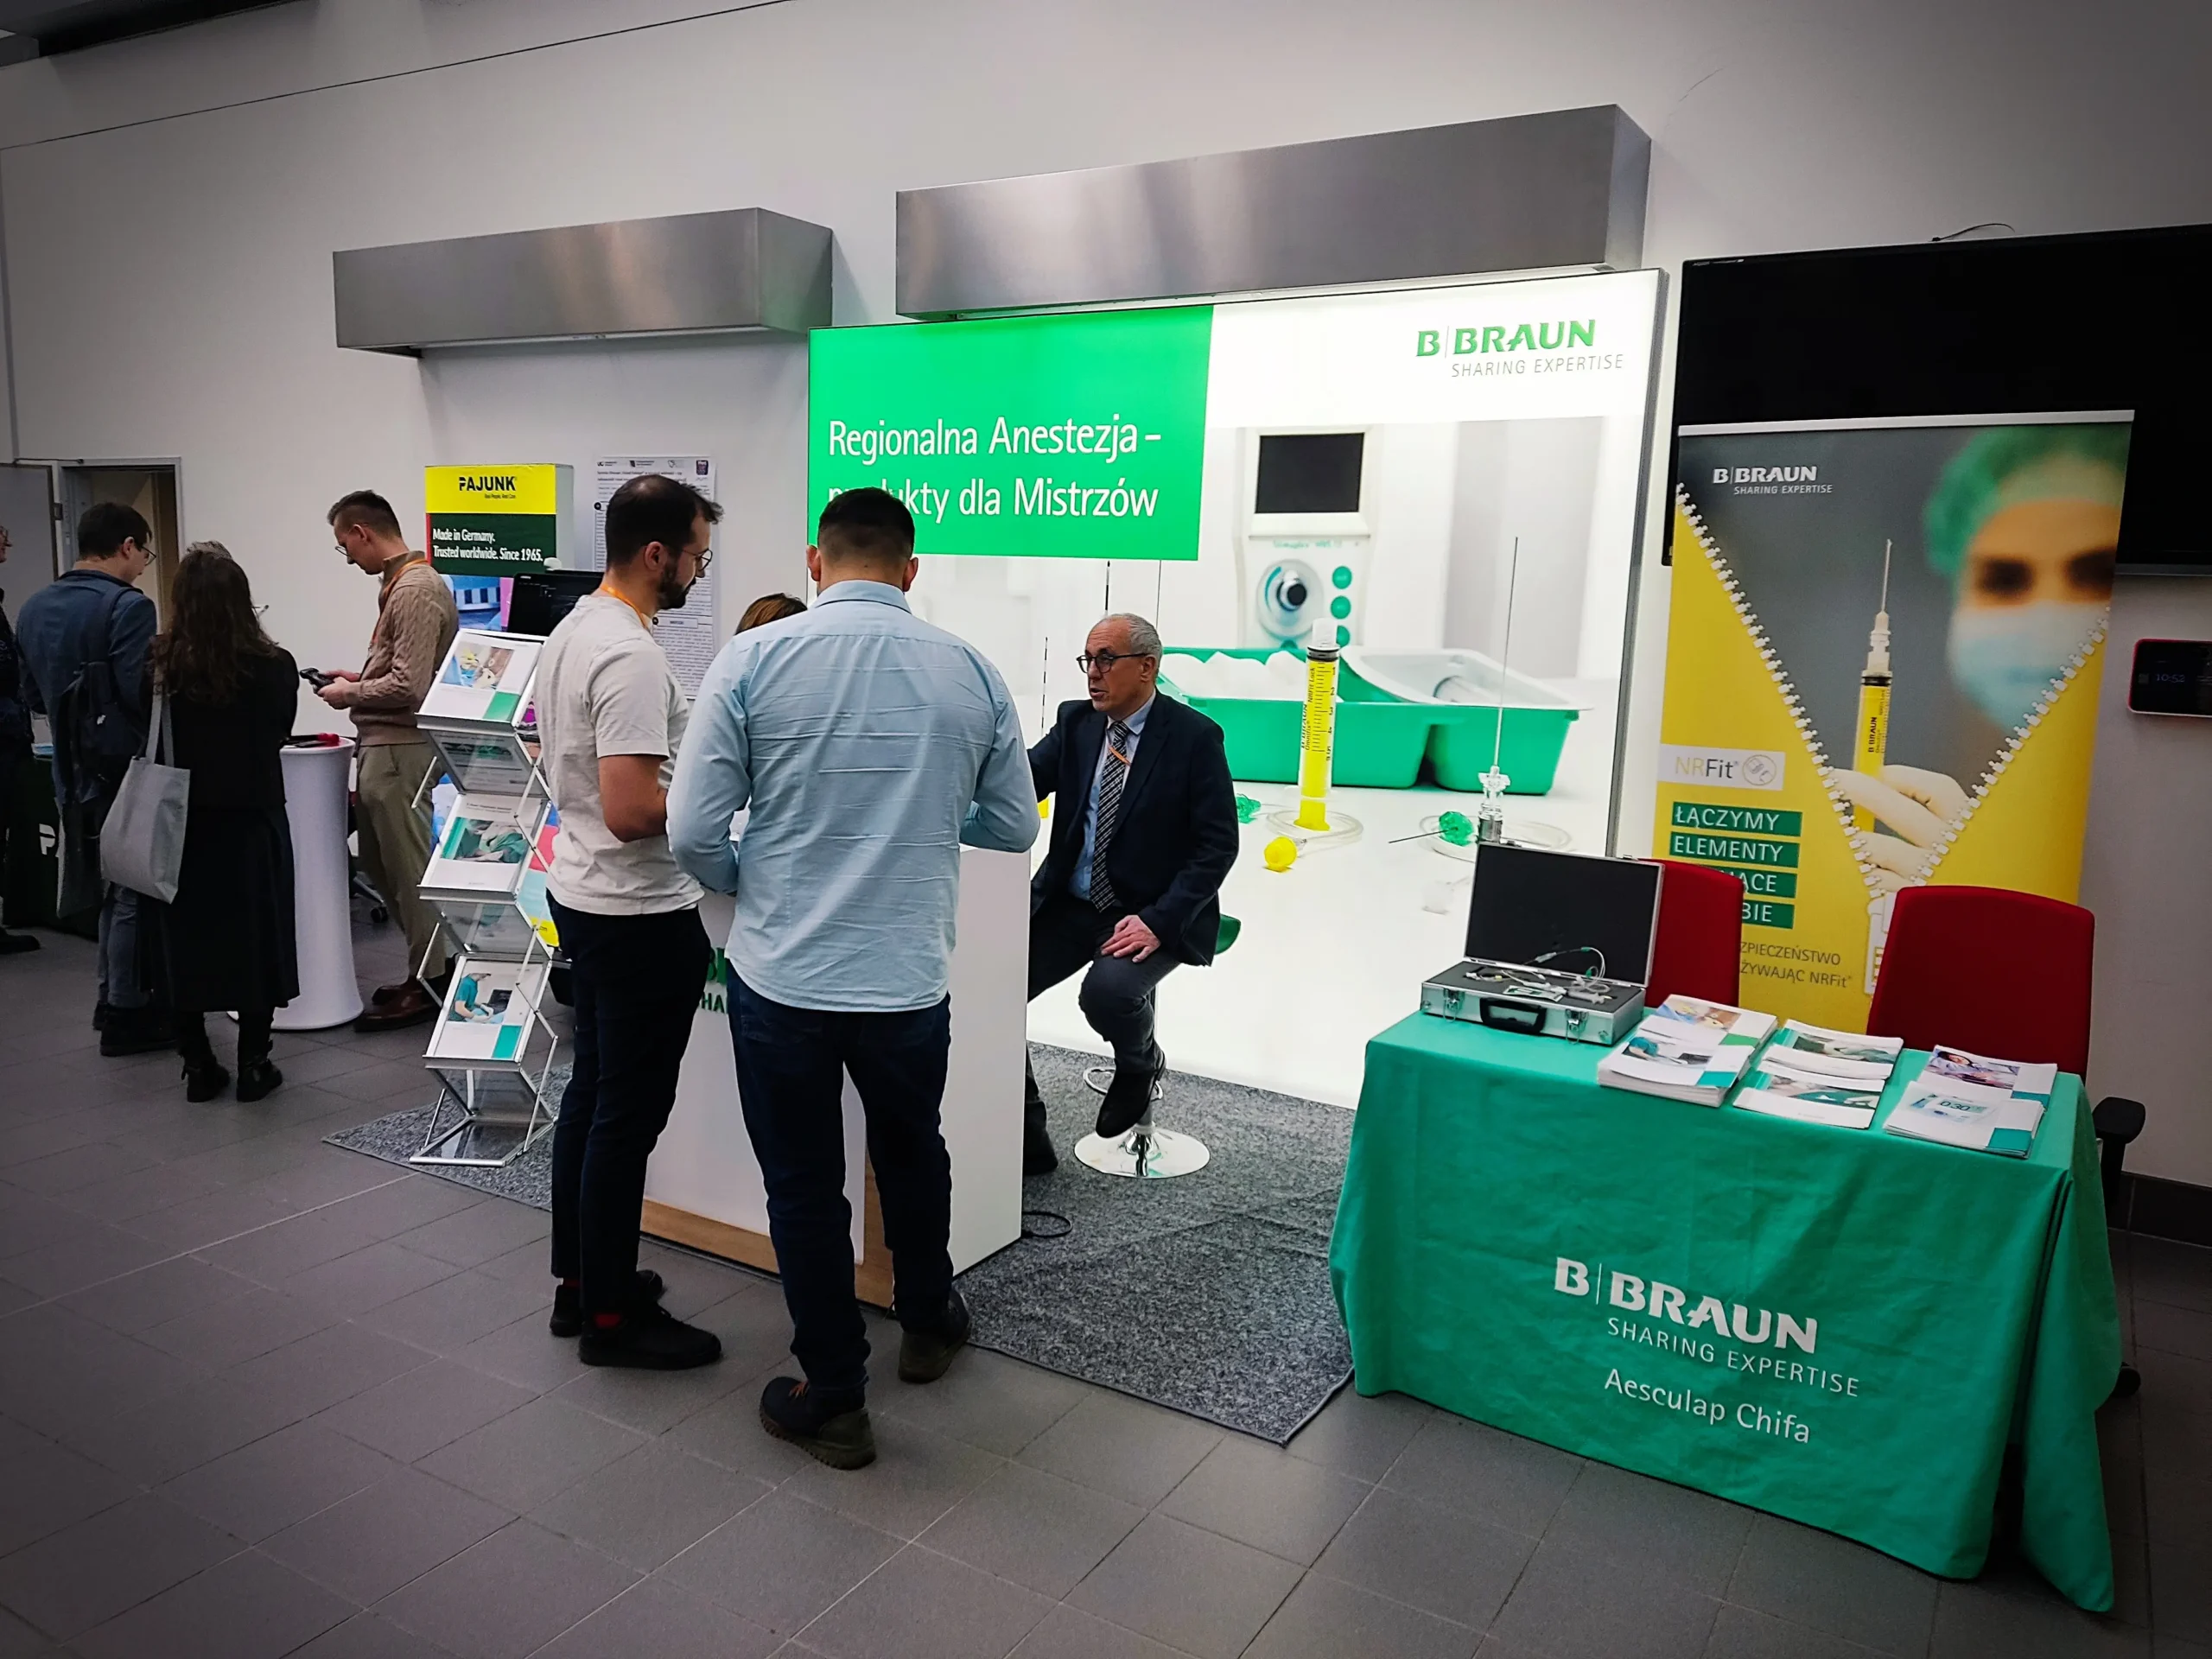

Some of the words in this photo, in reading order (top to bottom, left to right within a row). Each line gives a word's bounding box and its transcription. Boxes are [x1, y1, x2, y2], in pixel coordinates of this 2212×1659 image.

[1415, 330, 1441, 357] B
[1452, 319, 1596, 355] BRAUN
[1452, 359, 1526, 378] SHARING
[1535, 353, 1624, 373] EXPERTISE
[829, 418, 978, 467] Regionalna
[459, 476, 517, 492] PAJUNK
[1713, 467, 1729, 484] B
[1734, 466, 1817, 483] BRAUN
[958, 478, 1001, 516] dla
[1014, 476, 1160, 518] Mistrzów
[1733, 485, 1778, 495] SHARING
[1782, 484, 1834, 494] EXPERTISE
[433, 528, 452, 541] Made
[453, 528, 461, 541] in
[461, 529, 496, 544] Germany.
[433, 545, 459, 558] Trusted
[460, 546, 499, 560] worldwide.
[499, 548, 520, 561] Since
[521, 549, 543, 562] 1965.
[1675, 806, 1780, 831] ŁĄCZYMY
[1674, 836, 1783, 862] ELEMENTY
[1740, 941, 1841, 966] ZPIECZEŃSTWO
[1741, 959, 1806, 984] ŻYWAJĄC
[1554, 1256, 1591, 1297] B
[1609, 1270, 1819, 1355] BRAUN
[1607, 1317, 1715, 1363] SHARING
[1727, 1350, 1860, 1397] EXPERTISE
[1605, 1368, 1726, 1426] Aesculap
[1737, 1402, 1811, 1445] Chifa
